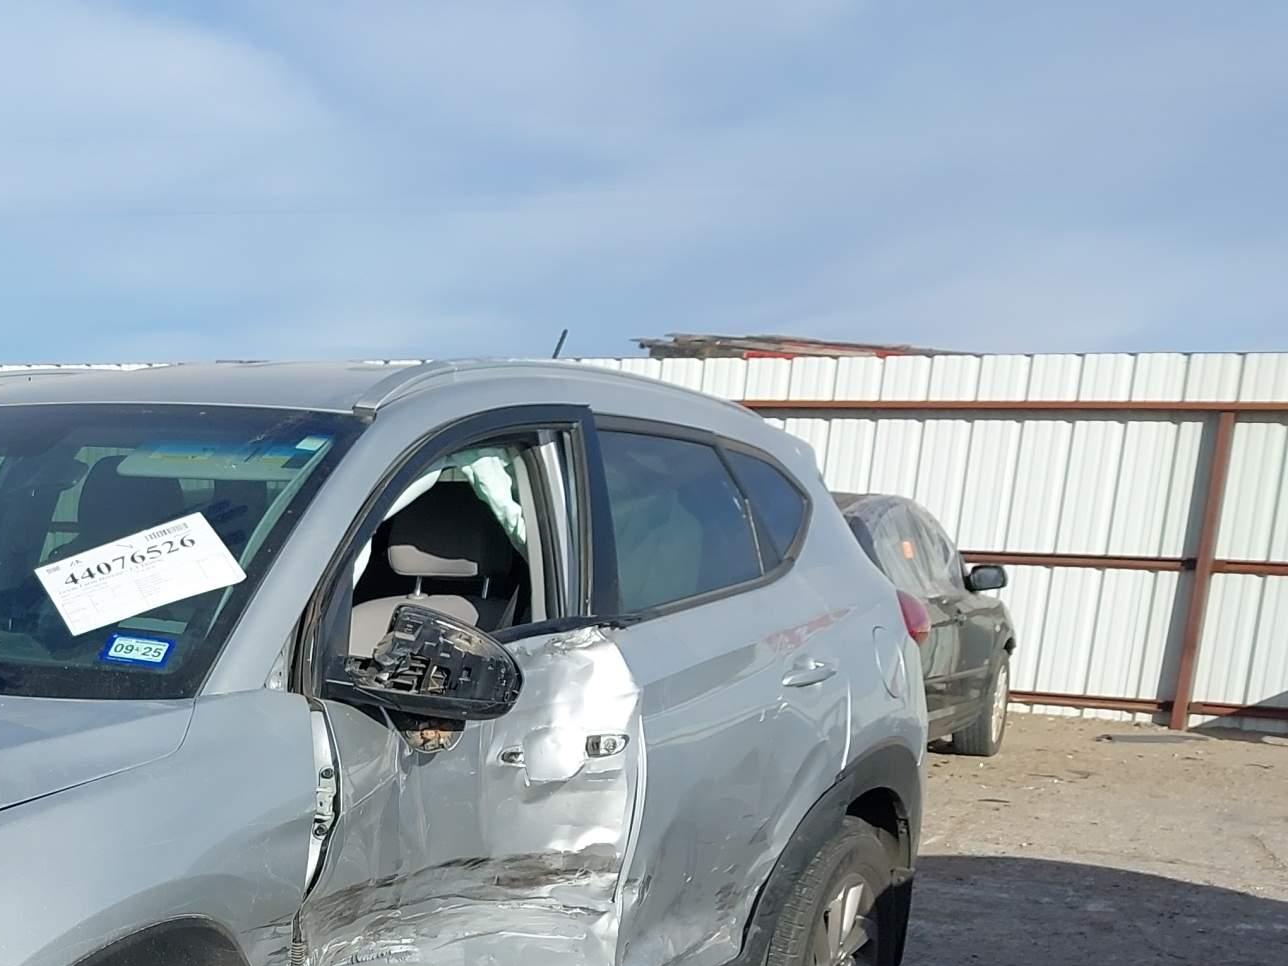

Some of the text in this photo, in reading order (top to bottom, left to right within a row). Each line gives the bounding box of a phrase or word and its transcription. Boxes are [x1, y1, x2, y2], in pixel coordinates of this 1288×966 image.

[64, 534, 196, 586] 44076526
[113, 643, 164, 658] 09 25
